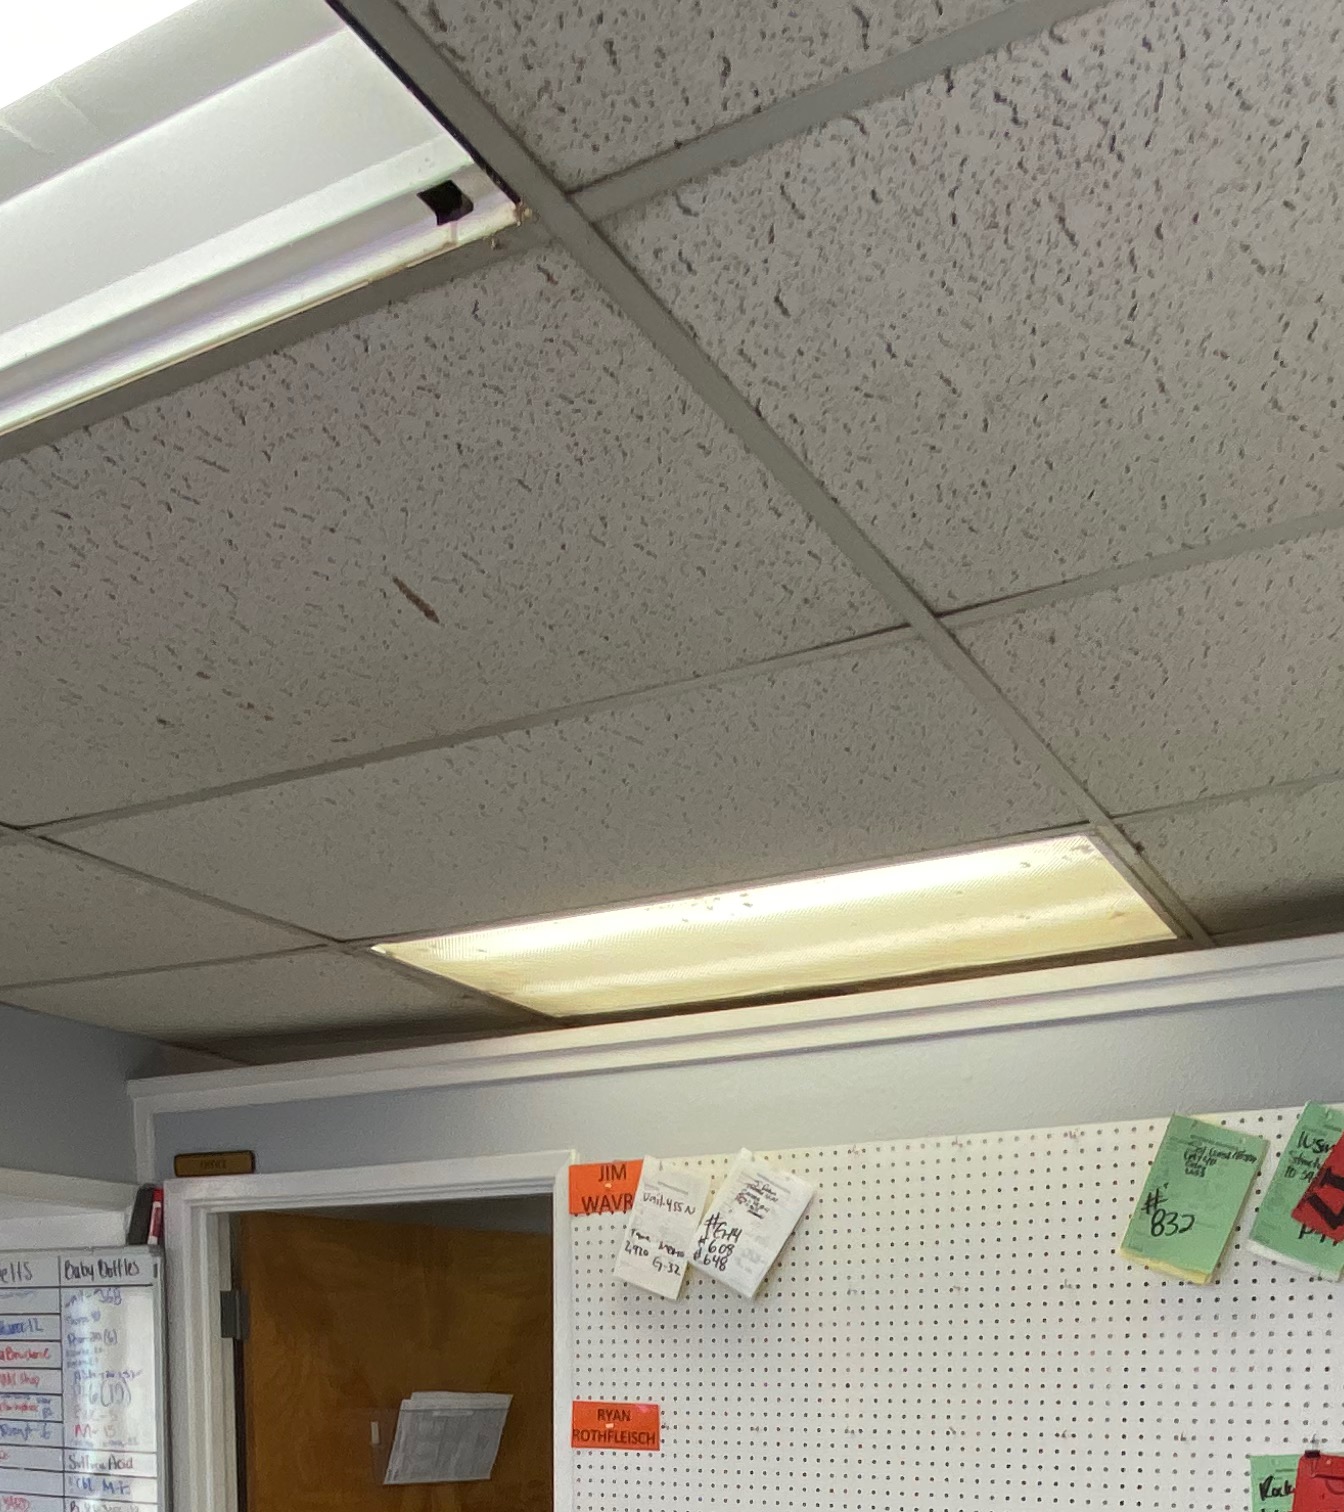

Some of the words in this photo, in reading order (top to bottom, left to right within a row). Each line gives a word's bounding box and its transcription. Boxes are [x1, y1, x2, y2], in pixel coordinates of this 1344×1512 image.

[597, 1163, 628, 1183] JIM
[1140, 1186, 1197, 1238] #832
[596, 1408, 632, 1423] RYAN
[572, 1428, 656, 1445] ROTHFLEISCH
